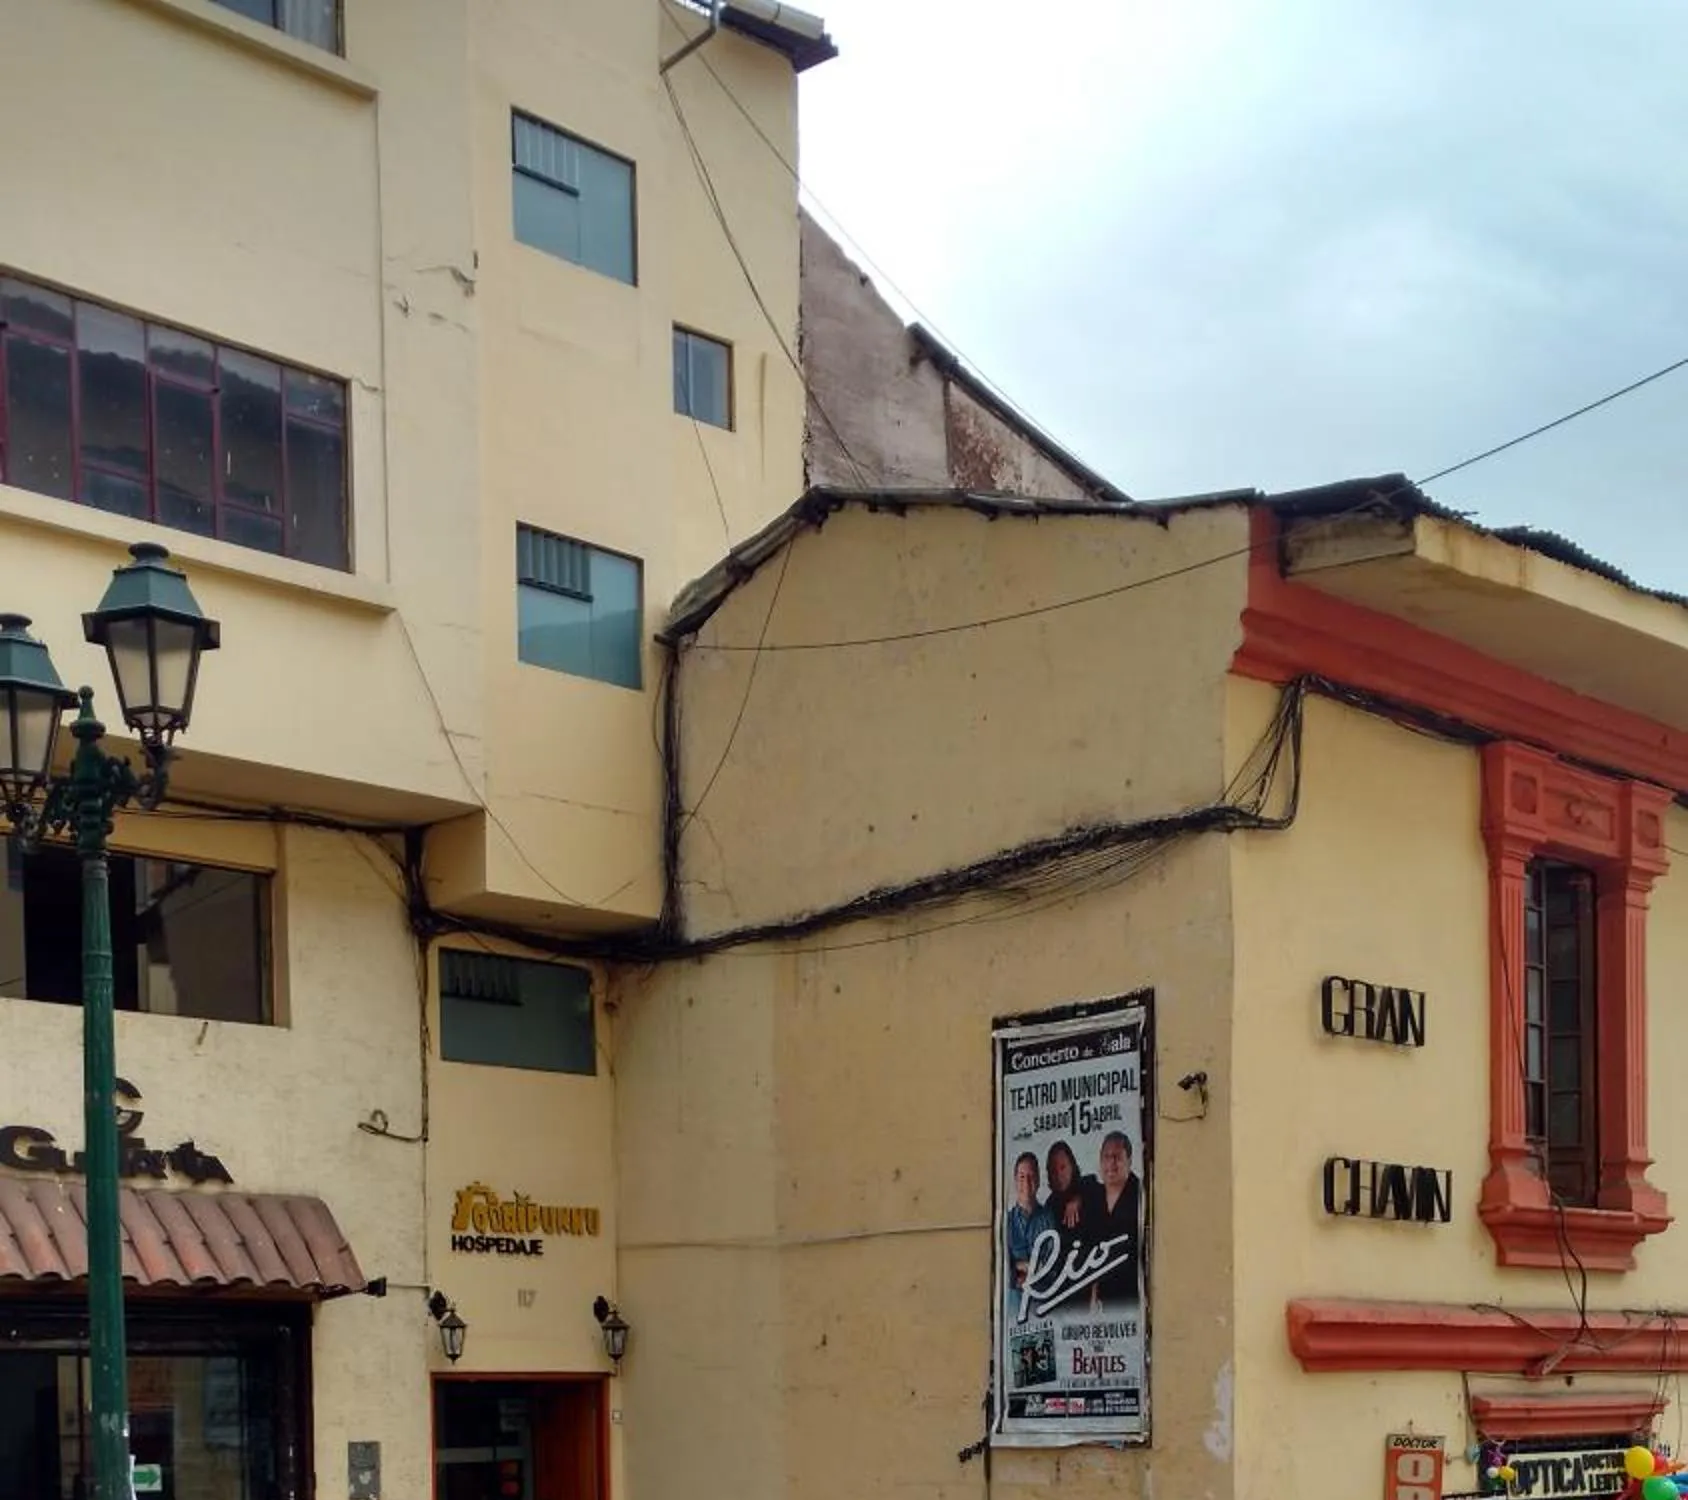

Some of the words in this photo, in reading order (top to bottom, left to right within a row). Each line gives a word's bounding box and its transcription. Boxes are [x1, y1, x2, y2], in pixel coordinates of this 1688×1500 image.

[1321, 975, 1426, 1048] GRAN
[1011, 1045, 1079, 1072] Concierto
[1010, 1081, 1057, 1112] TEATRO
[1061, 1067, 1138, 1102] MUNICIPAL
[1069, 1099, 1092, 1136] 15
[1093, 1103, 1122, 1123] ABRIL
[451, 1234, 544, 1257] HOSPEDAJE
[1061, 1324, 1091, 1341] GRUPO
[1393, 1436, 1437, 1449] DOCTOR
[1508, 1458, 1587, 1496] OPTICA
